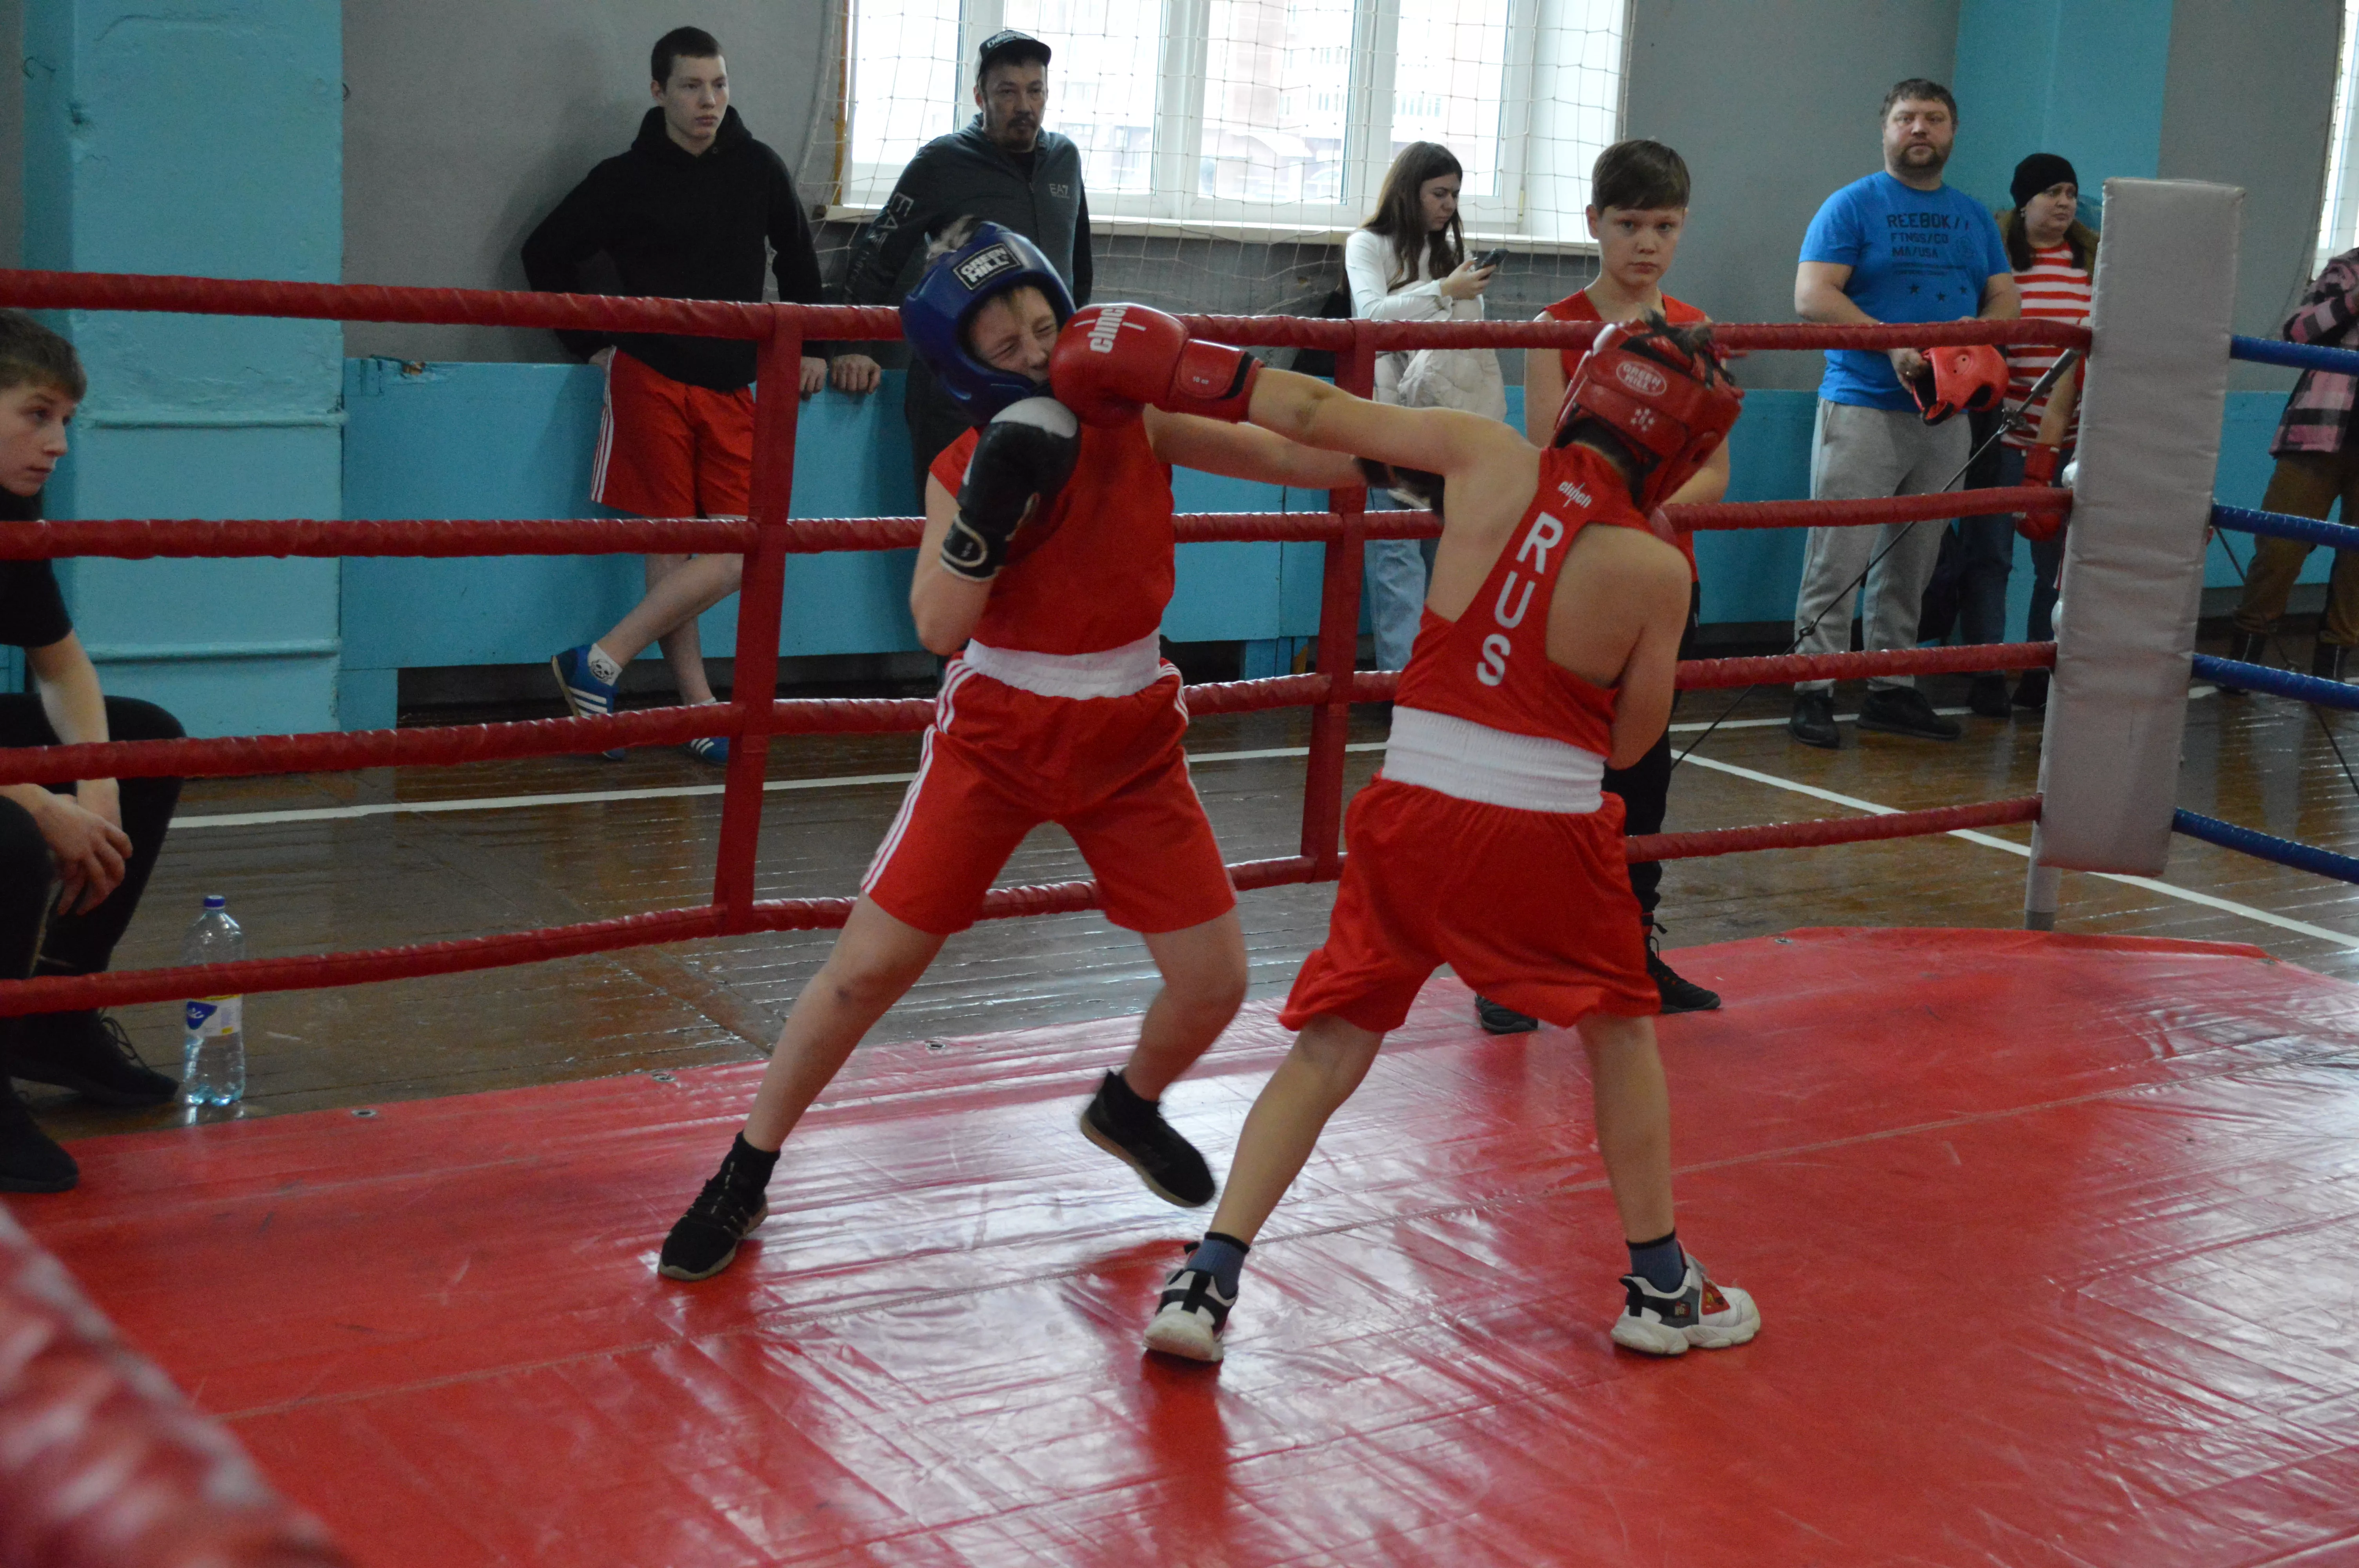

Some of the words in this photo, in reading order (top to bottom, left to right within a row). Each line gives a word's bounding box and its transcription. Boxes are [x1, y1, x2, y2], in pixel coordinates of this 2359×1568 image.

[1049, 183, 1069, 196] EA7
[961, 247, 1007, 275] GREEN
[966, 256, 1010, 283] HILL
[1623, 364, 1662, 387] GREEN
[1624, 374, 1648, 391] HILL
[1558, 481, 1592, 508] clinch
[1476, 511, 1564, 686] RUS
